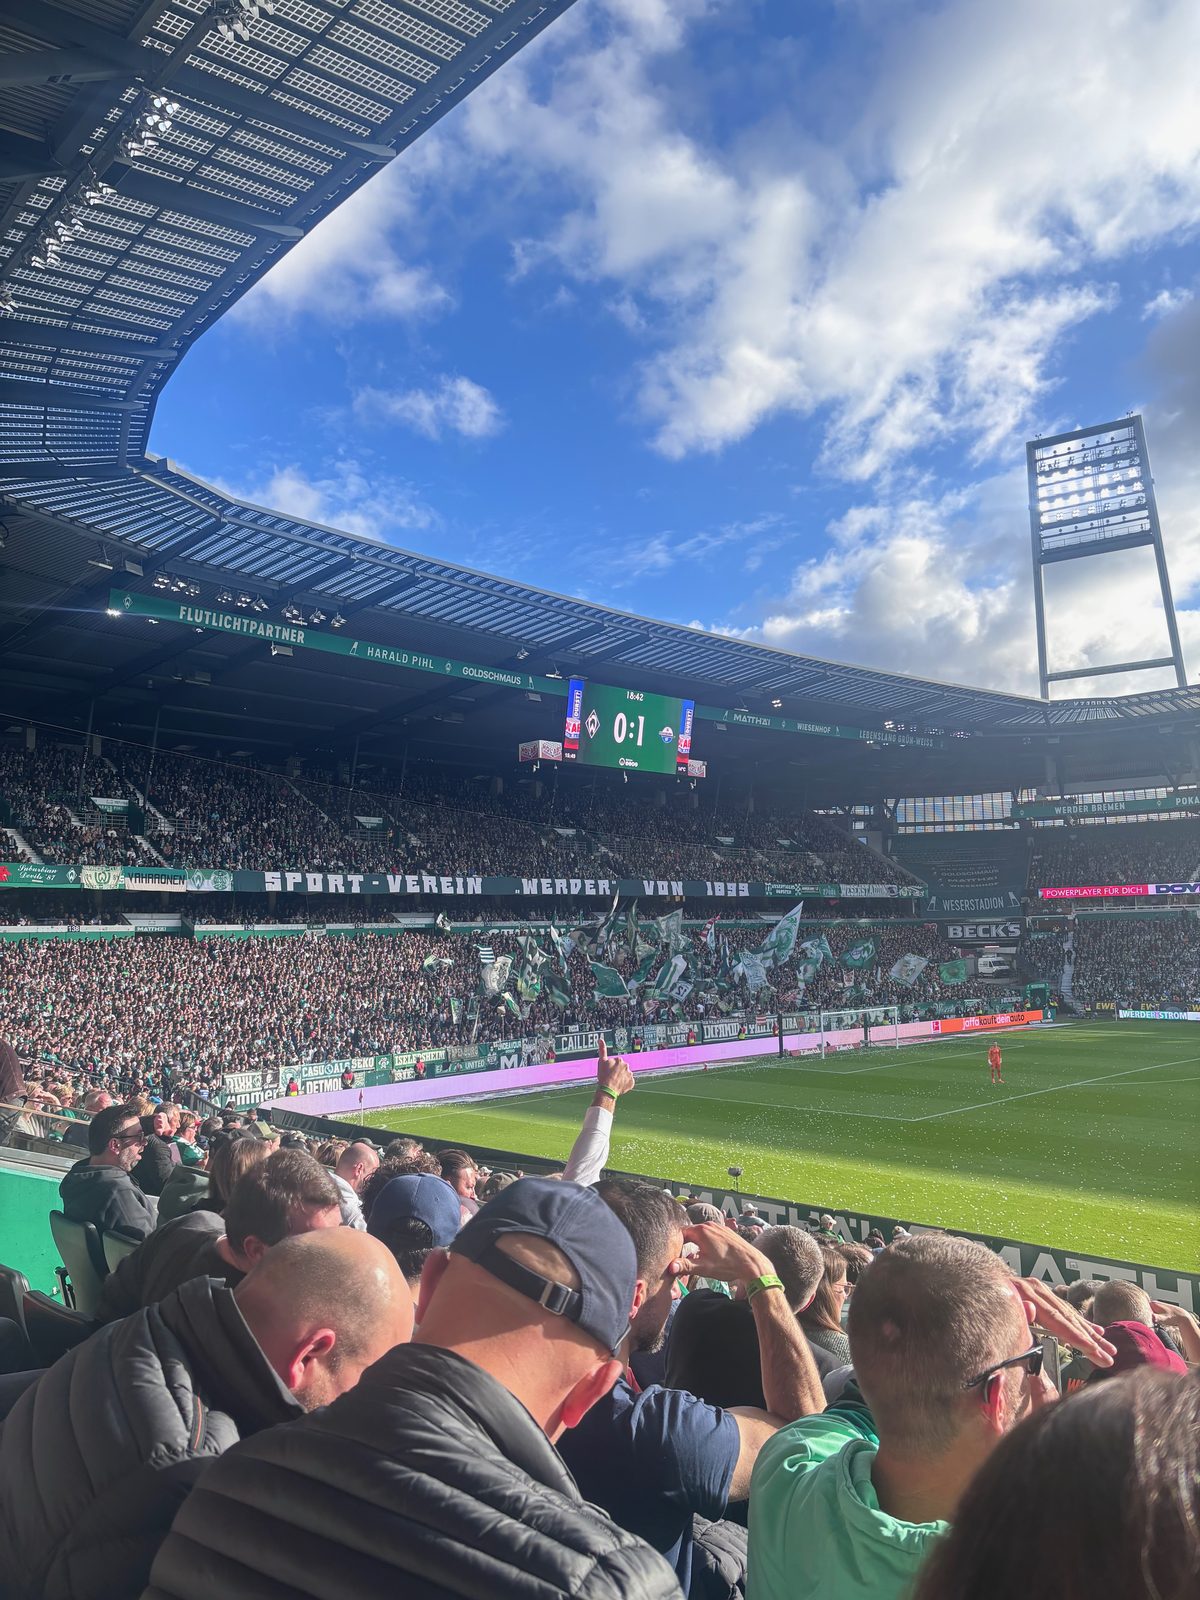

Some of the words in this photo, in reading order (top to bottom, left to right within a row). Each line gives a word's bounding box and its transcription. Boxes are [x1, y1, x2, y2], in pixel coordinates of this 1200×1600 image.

[179, 605, 305, 644] FLUTLICHTPARTNER
[367, 646, 408, 664] HARALD
[411, 655, 434, 669] PIHL
[462, 666, 522, 685] GOLDSCHMAUS
[626, 690, 644, 702] 18:42
[613, 712, 645, 747] 0:1
[796, 722, 831, 734] WIESENHOF
[1054, 804, 1089, 815] WERDER
[1091, 802, 1126, 813] BREMEN
[18, 864, 59, 874] Suburbian
[19, 872, 43, 880] Devils
[642, 880, 684, 896] VON
[705, 881, 750, 897] 1899
[1046, 888, 1102, 897] POWERPLAYER
[1121, 886, 1143, 894] DICH
[942, 896, 1004, 911] WESERSTADION
[1121, 1010, 1156, 1019] WERDER
[1159, 1011, 1188, 1020] STROM
[351, 1056, 375, 1069] SEKO
[306, 1078, 344, 1094] DETMOL
